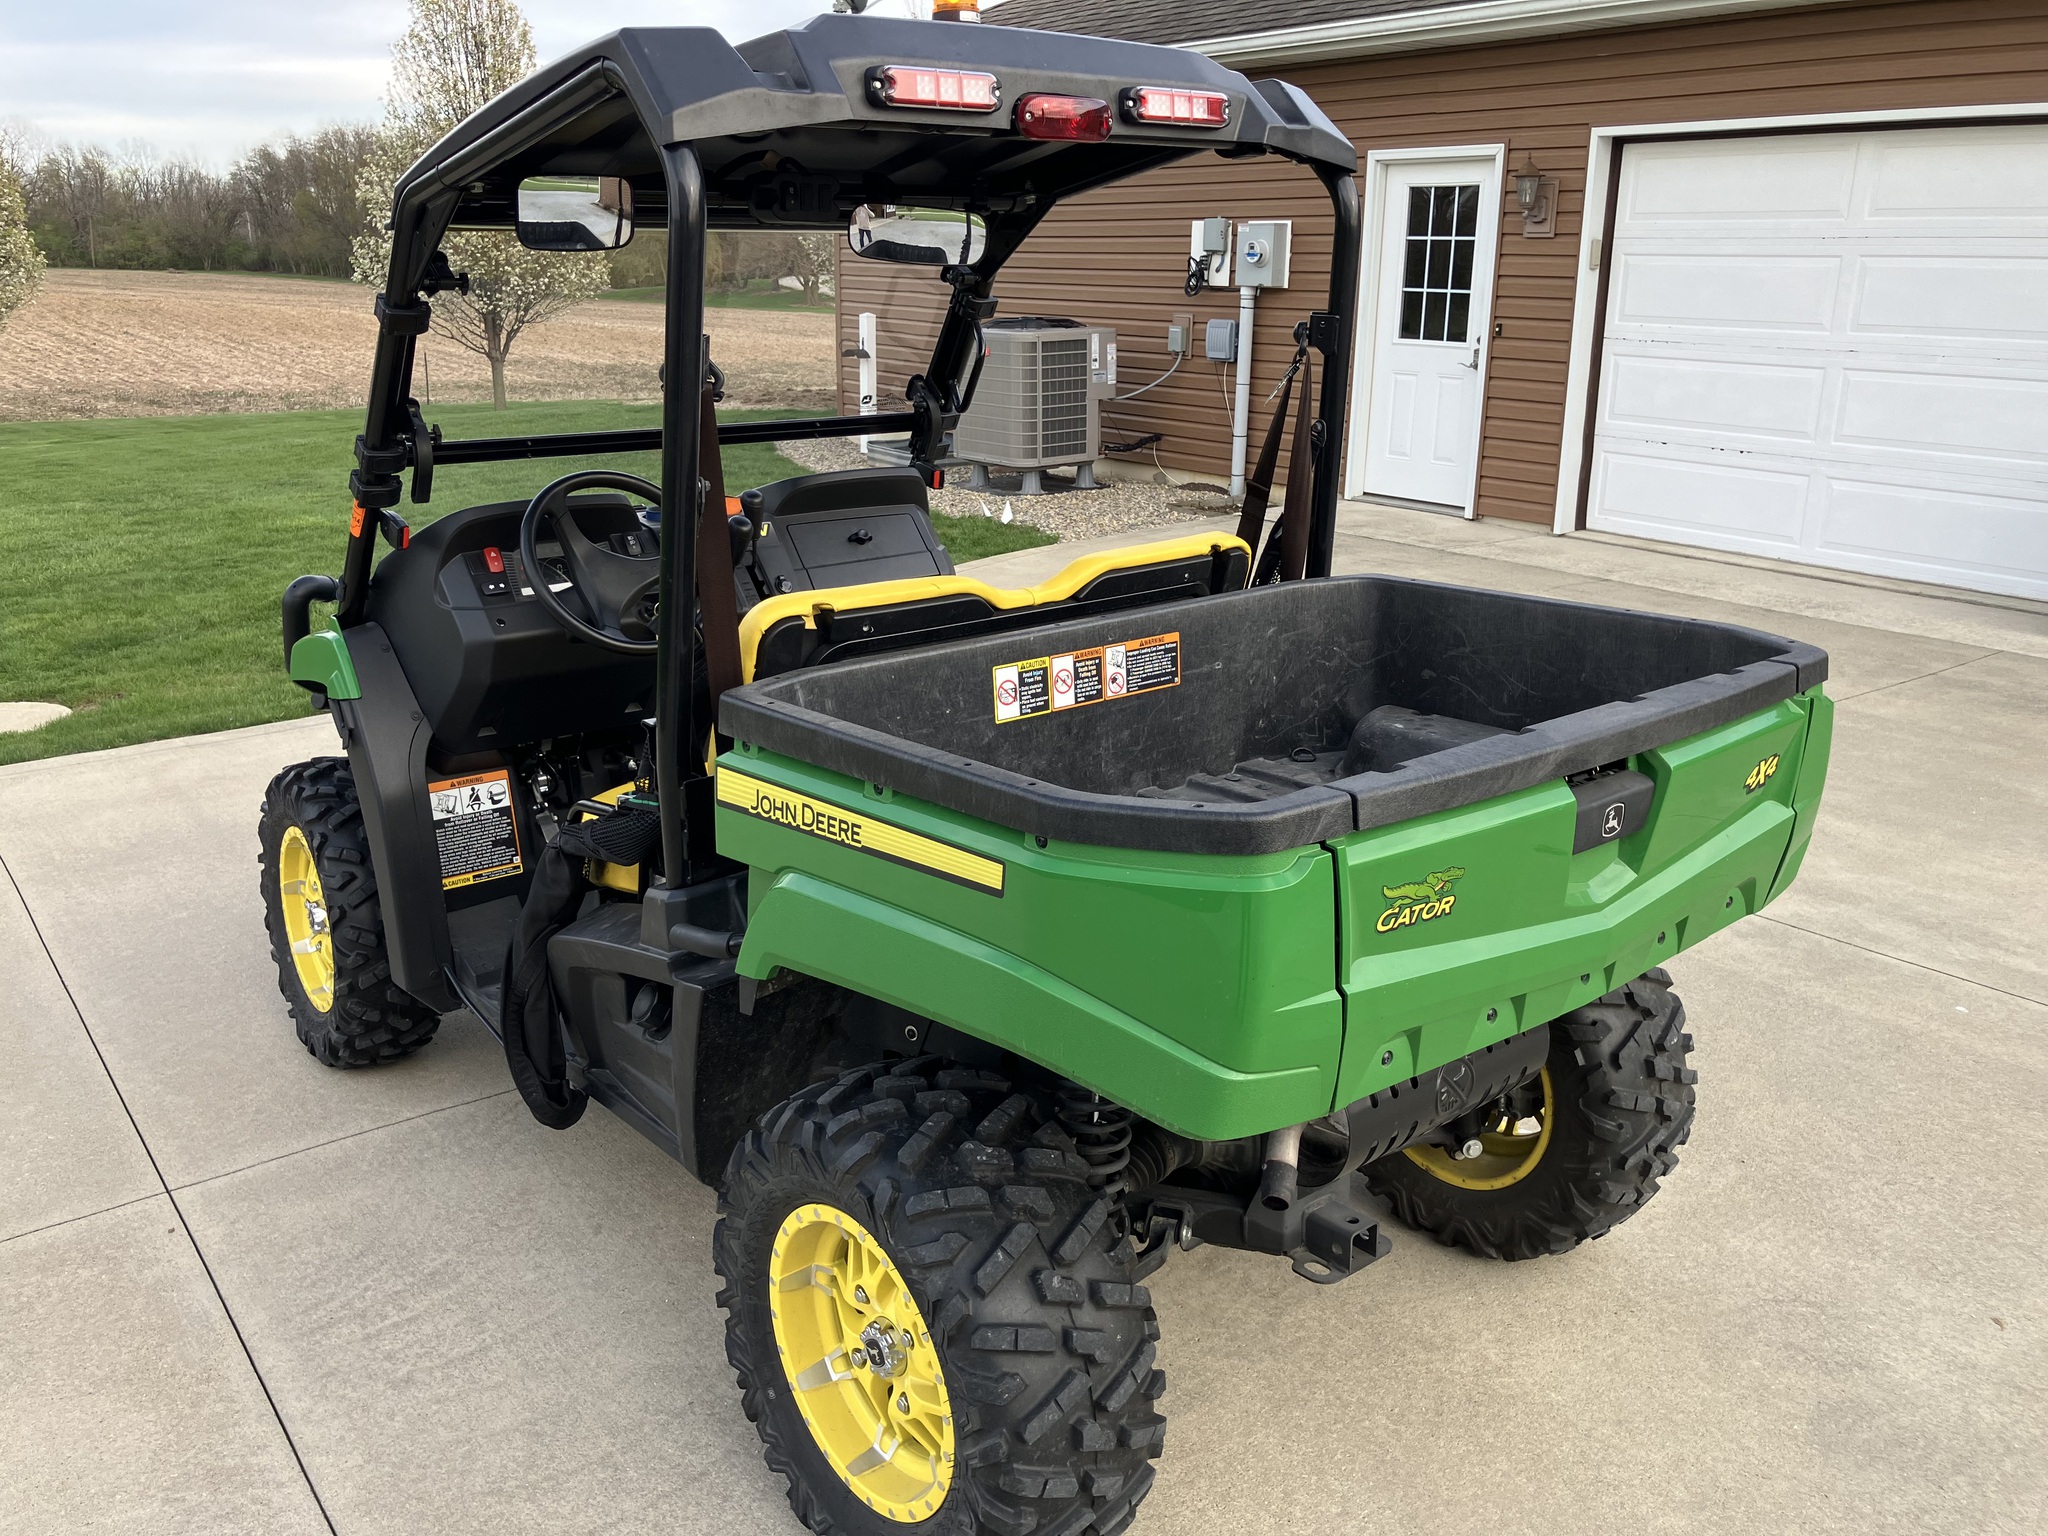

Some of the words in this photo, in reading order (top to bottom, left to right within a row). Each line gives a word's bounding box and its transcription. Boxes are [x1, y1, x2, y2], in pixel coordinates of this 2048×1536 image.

[1026, 659, 1046, 668] CAUTION
[456, 776, 484, 787] WARNING
[1744, 754, 1780, 792] 4X4
[750, 788, 797, 824] JOHN
[801, 802, 862, 845] DEERE
[447, 877, 471, 887] CAUTION
[1375, 895, 1456, 933] GATOR
